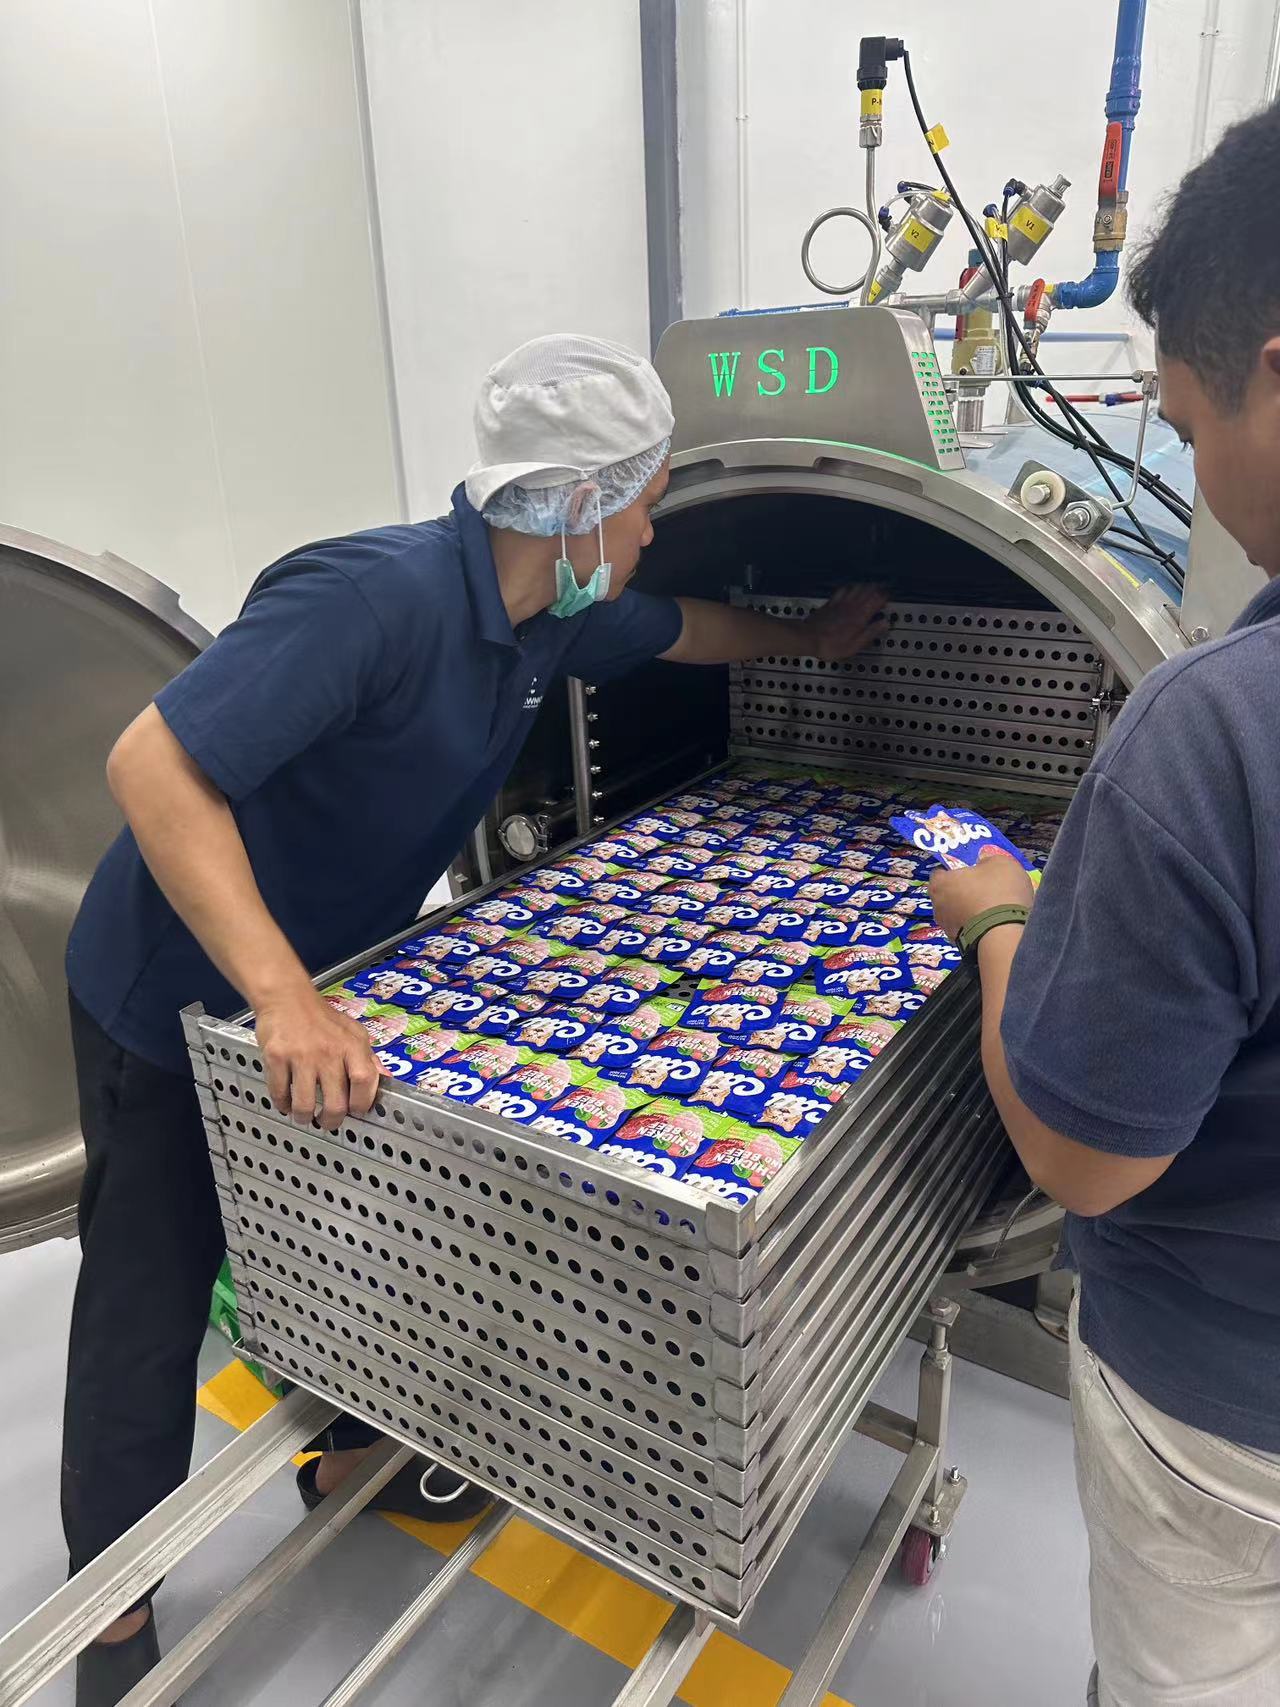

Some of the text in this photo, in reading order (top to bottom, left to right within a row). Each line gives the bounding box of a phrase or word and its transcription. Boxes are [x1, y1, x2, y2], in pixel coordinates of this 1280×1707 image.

[1025, 220, 1035, 231] V1
[910, 229, 921, 239] V2
[636, 1127, 695, 1154] CHICKEN
